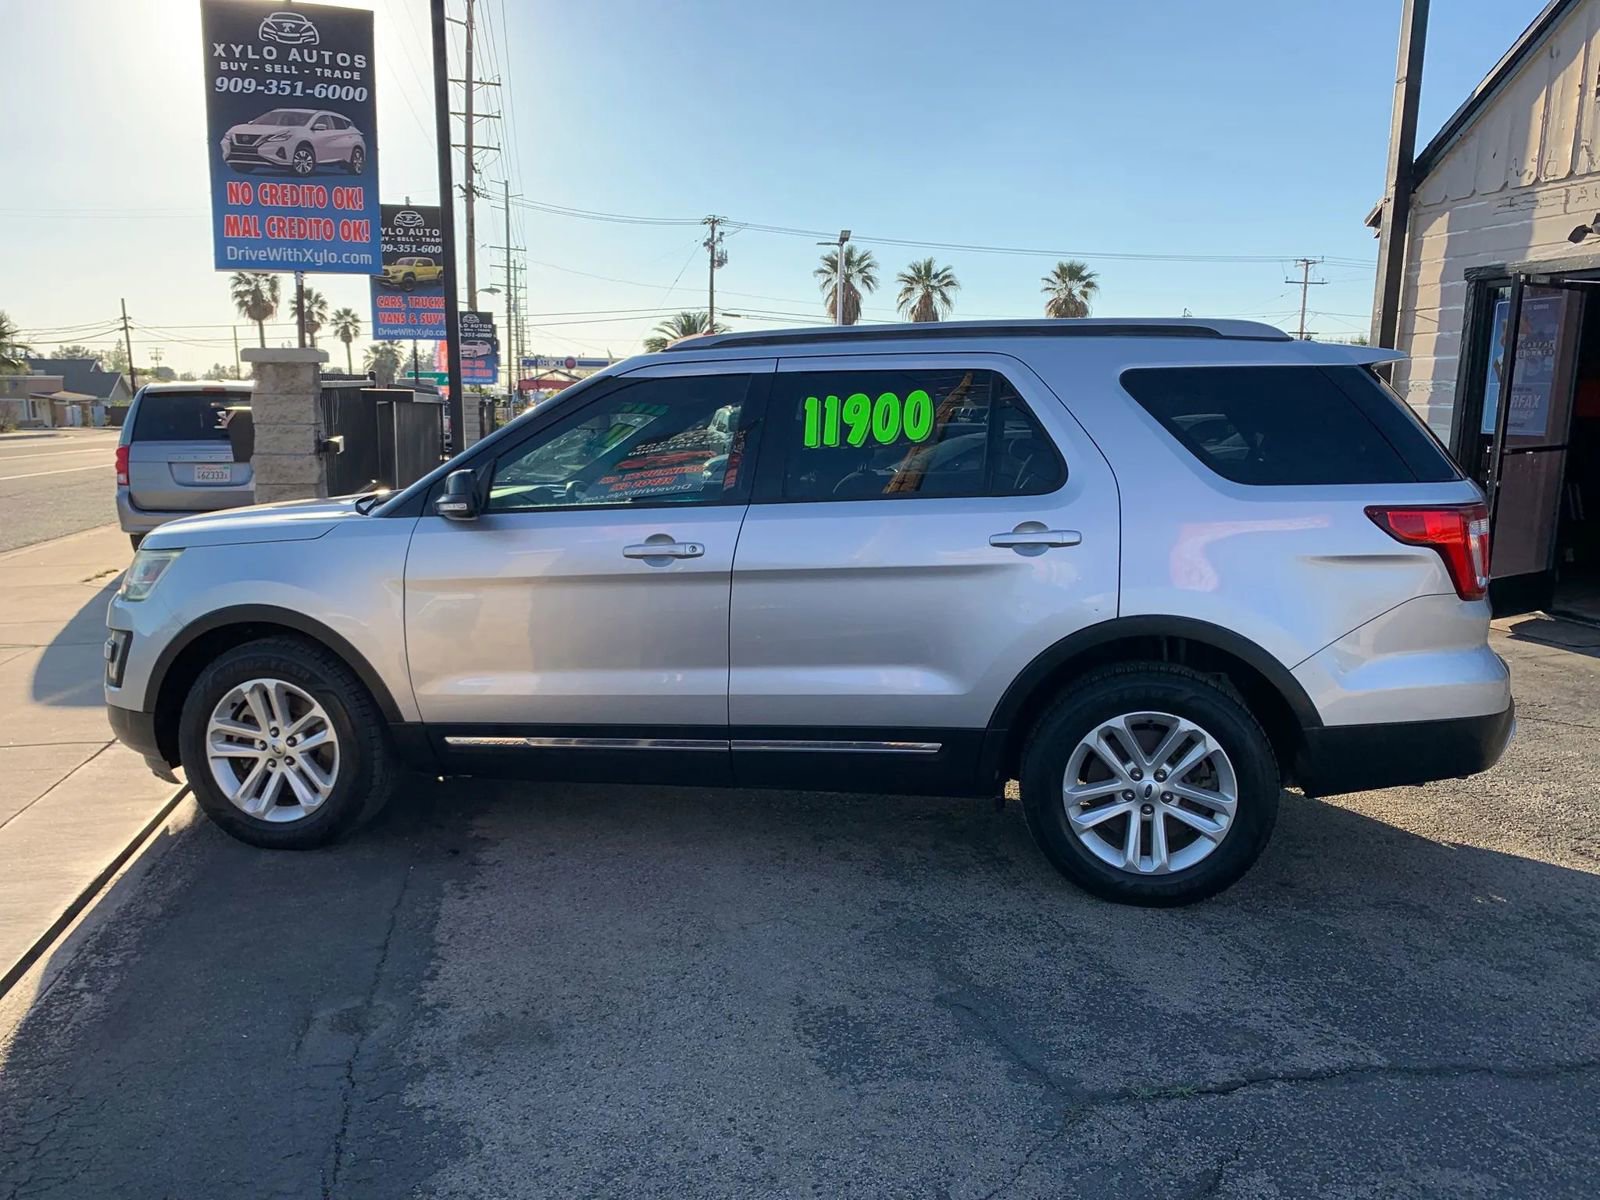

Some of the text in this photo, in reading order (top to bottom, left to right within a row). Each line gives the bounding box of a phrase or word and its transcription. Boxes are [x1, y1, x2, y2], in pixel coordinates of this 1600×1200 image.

[213, 42, 367, 68] XYLO AUTOS
[220, 61, 248, 71] BUY
[265, 64, 298, 74] SELL
[315, 67, 361, 80] TRADE
[215, 76, 368, 102] 909-351-6000
[226, 181, 364, 211] NO CREDITO OK!
[224, 214, 371, 243] MAL CREDITO OK!
[381, 227, 440, 236] YLO AUTO
[227, 245, 372, 266] DriveWithXylo.com
[381, 244, 442, 253] 09-351-600
[377, 296, 406, 310] CARS,
[378, 312, 406, 325] VANS
[408, 313, 417, 325] &
[378, 327, 447, 338] DriveWithXylo.co
[1510, 394, 1541, 409] RFAX
[804, 389, 934, 448] 11900
